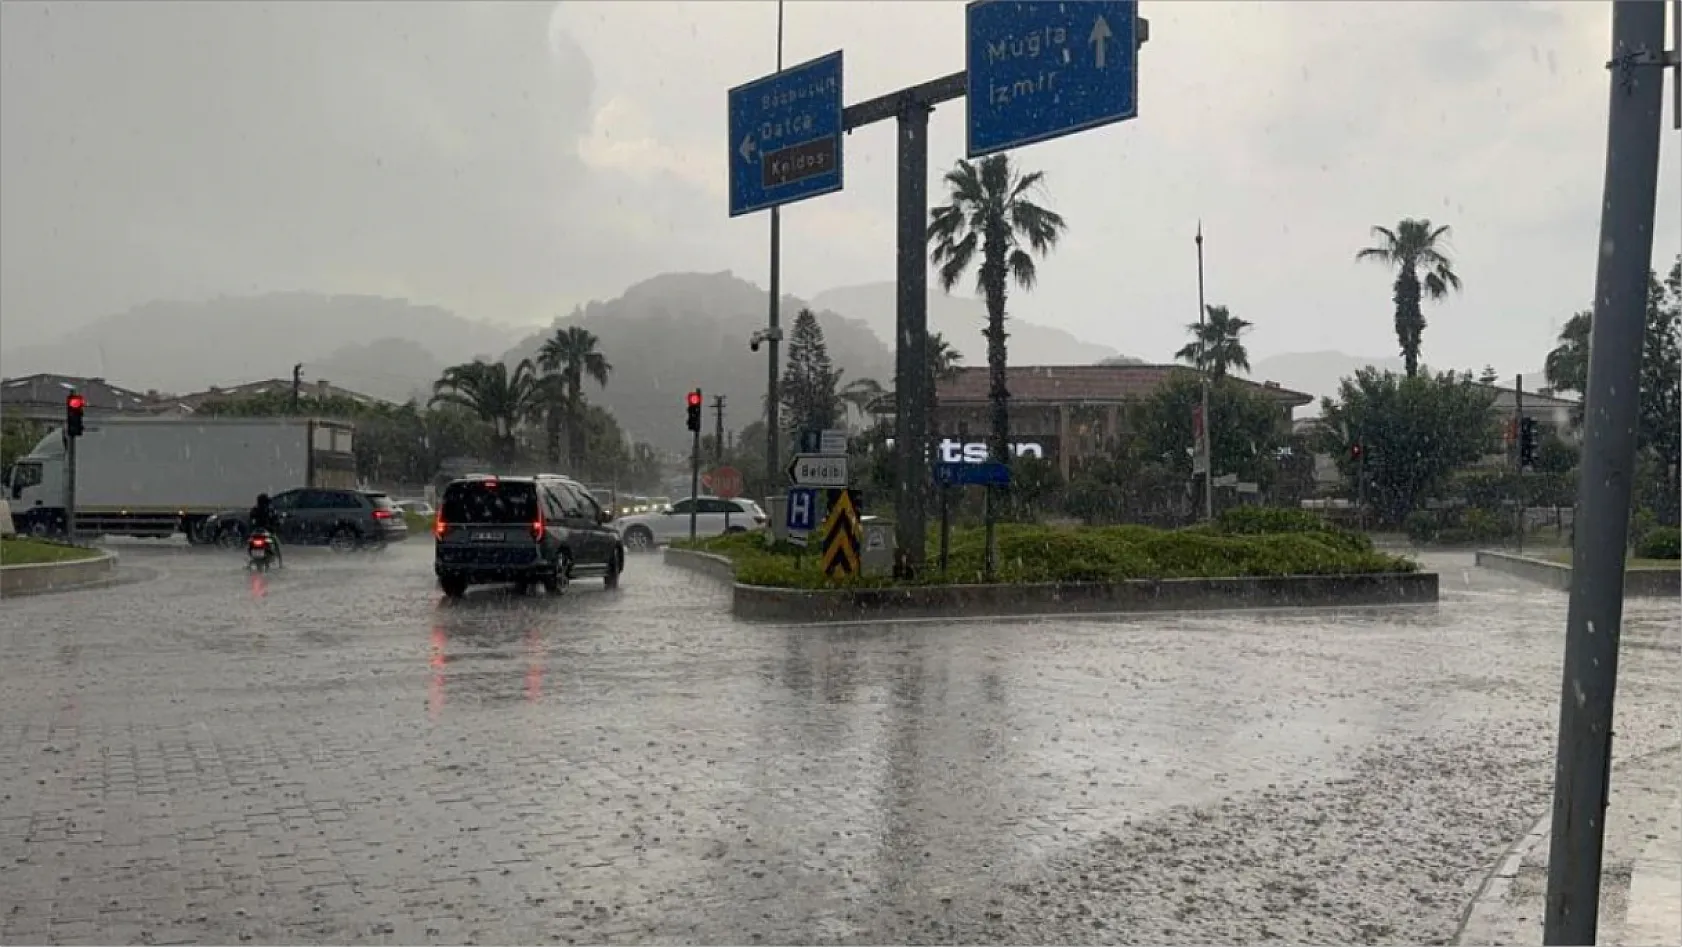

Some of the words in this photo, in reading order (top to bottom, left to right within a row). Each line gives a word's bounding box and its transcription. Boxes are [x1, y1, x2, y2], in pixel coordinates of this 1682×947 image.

[987, 24, 1068, 65] Muğla
[989, 70, 1059, 106] İzmir
[761, 113, 813, 140] Datça
[790, 492, 809, 525] H
